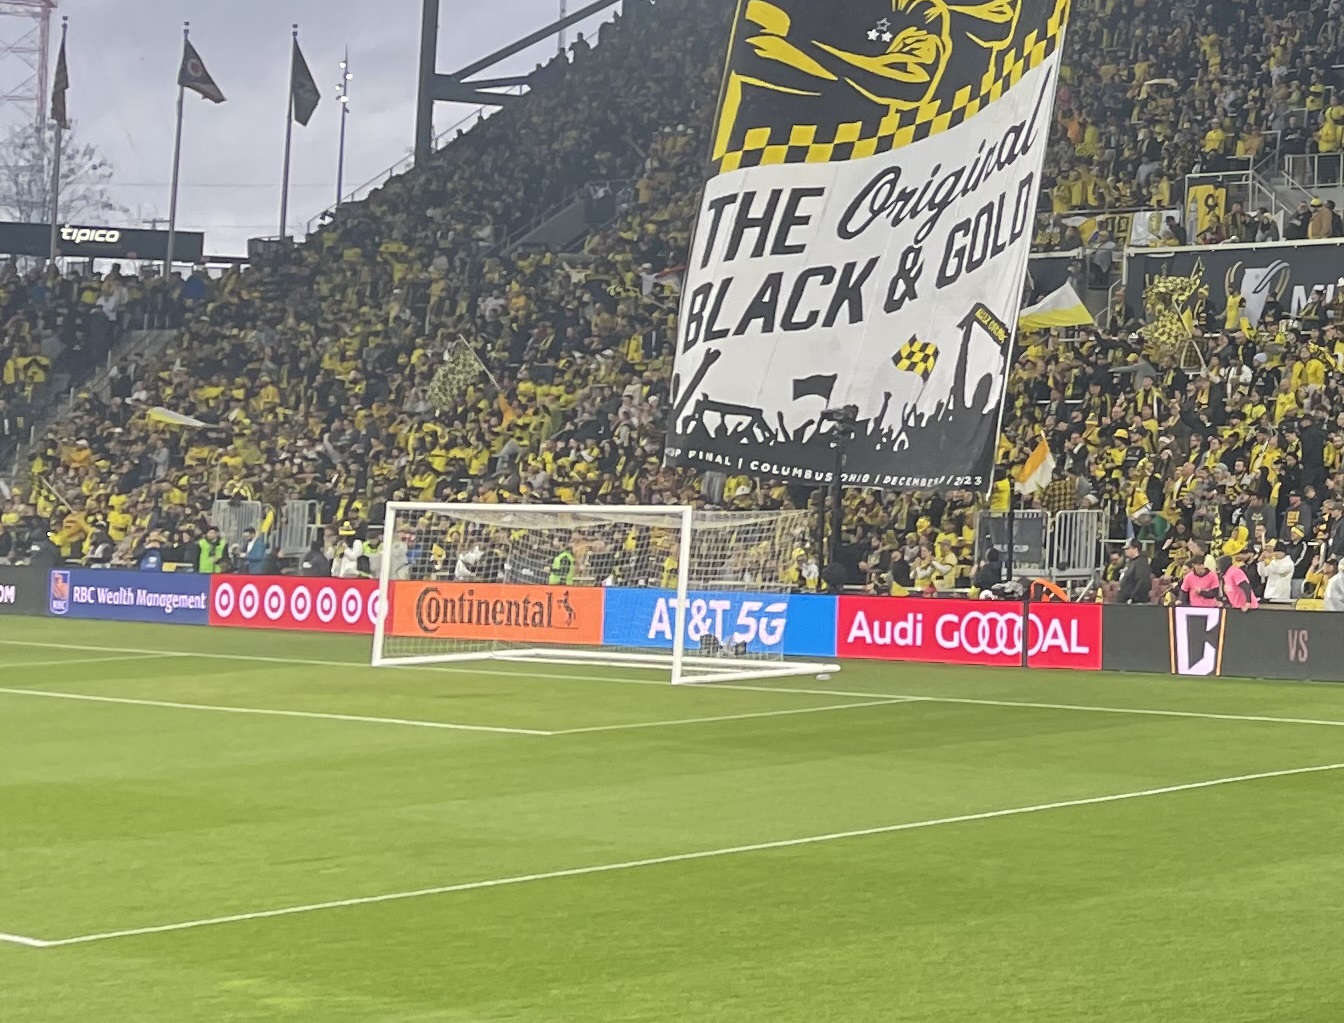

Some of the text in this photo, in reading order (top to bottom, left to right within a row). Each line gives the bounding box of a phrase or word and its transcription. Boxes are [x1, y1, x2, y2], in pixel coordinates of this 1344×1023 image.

[706, 65, 1054, 269] THE Original
[61, 224, 121, 244] tipico
[682, 172, 1034, 355] BLACK & GOLD
[688, 450, 732, 467] FINAL
[750, 461, 834, 483] COLUMBUS
[73, 586, 207, 614] RBC Wealth Management
[415, 587, 554, 633] Continental
[648, 597, 789, 645] AT&T 5G
[847, 611, 923, 646] Audi
[1288, 629, 1310, 664] VS
